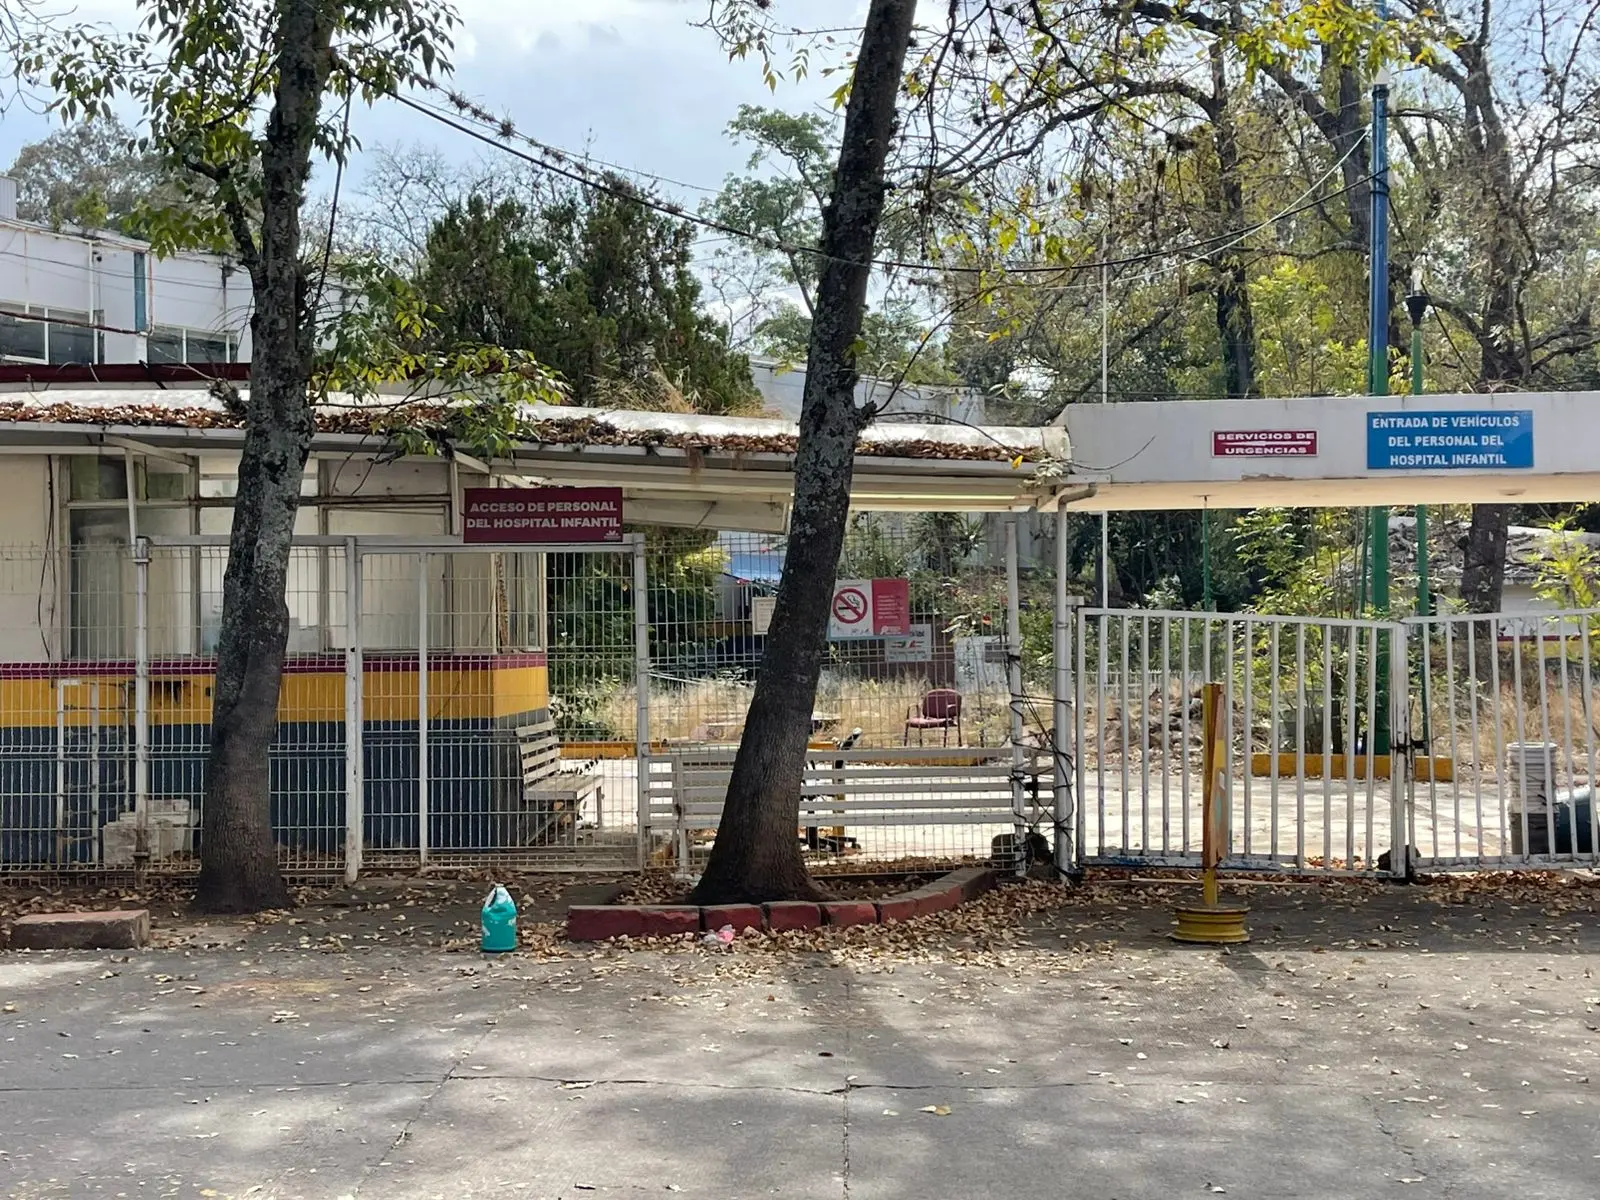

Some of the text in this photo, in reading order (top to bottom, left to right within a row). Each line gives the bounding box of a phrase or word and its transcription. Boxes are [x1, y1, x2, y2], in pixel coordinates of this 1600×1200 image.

[1372, 414, 1520, 428] ENTRADA DE VEHÍCULOS
[1388, 435, 1505, 446] DEL PERSONAL DEL
[1390, 454, 1507, 466] HOSPITAL INFANTIL
[470, 501, 618, 512] ACCESO DE PERSONAL
[466, 517, 620, 528] DEL HOSPITAL INFANTIL
